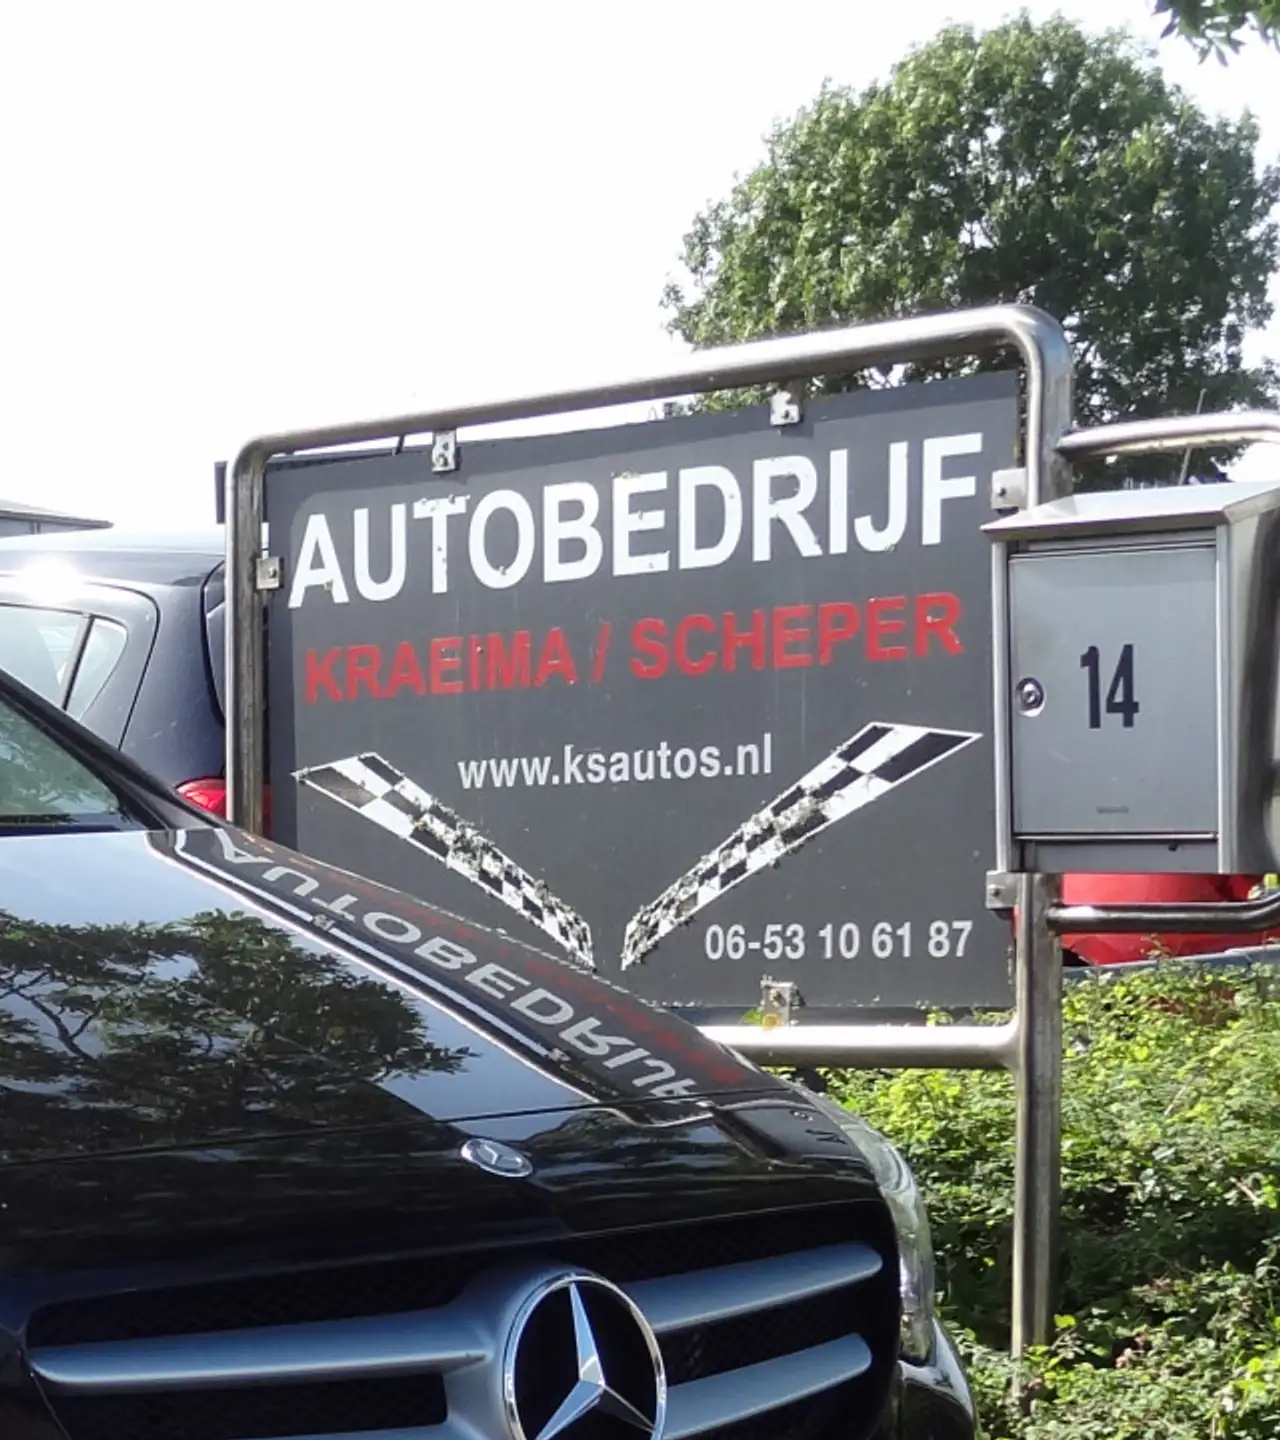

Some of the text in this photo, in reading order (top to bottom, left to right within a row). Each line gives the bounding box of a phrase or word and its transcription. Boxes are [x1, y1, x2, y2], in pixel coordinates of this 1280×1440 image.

[288, 432, 983, 609] AUTOBEDRIJF
[305, 591, 965, 704] KRAEIMA / SCHEPER
[1080, 643, 1140, 729] 14
[458, 733, 773, 790] www.ksautos.nl
[704, 919, 974, 960] 06-53 10 61 87
